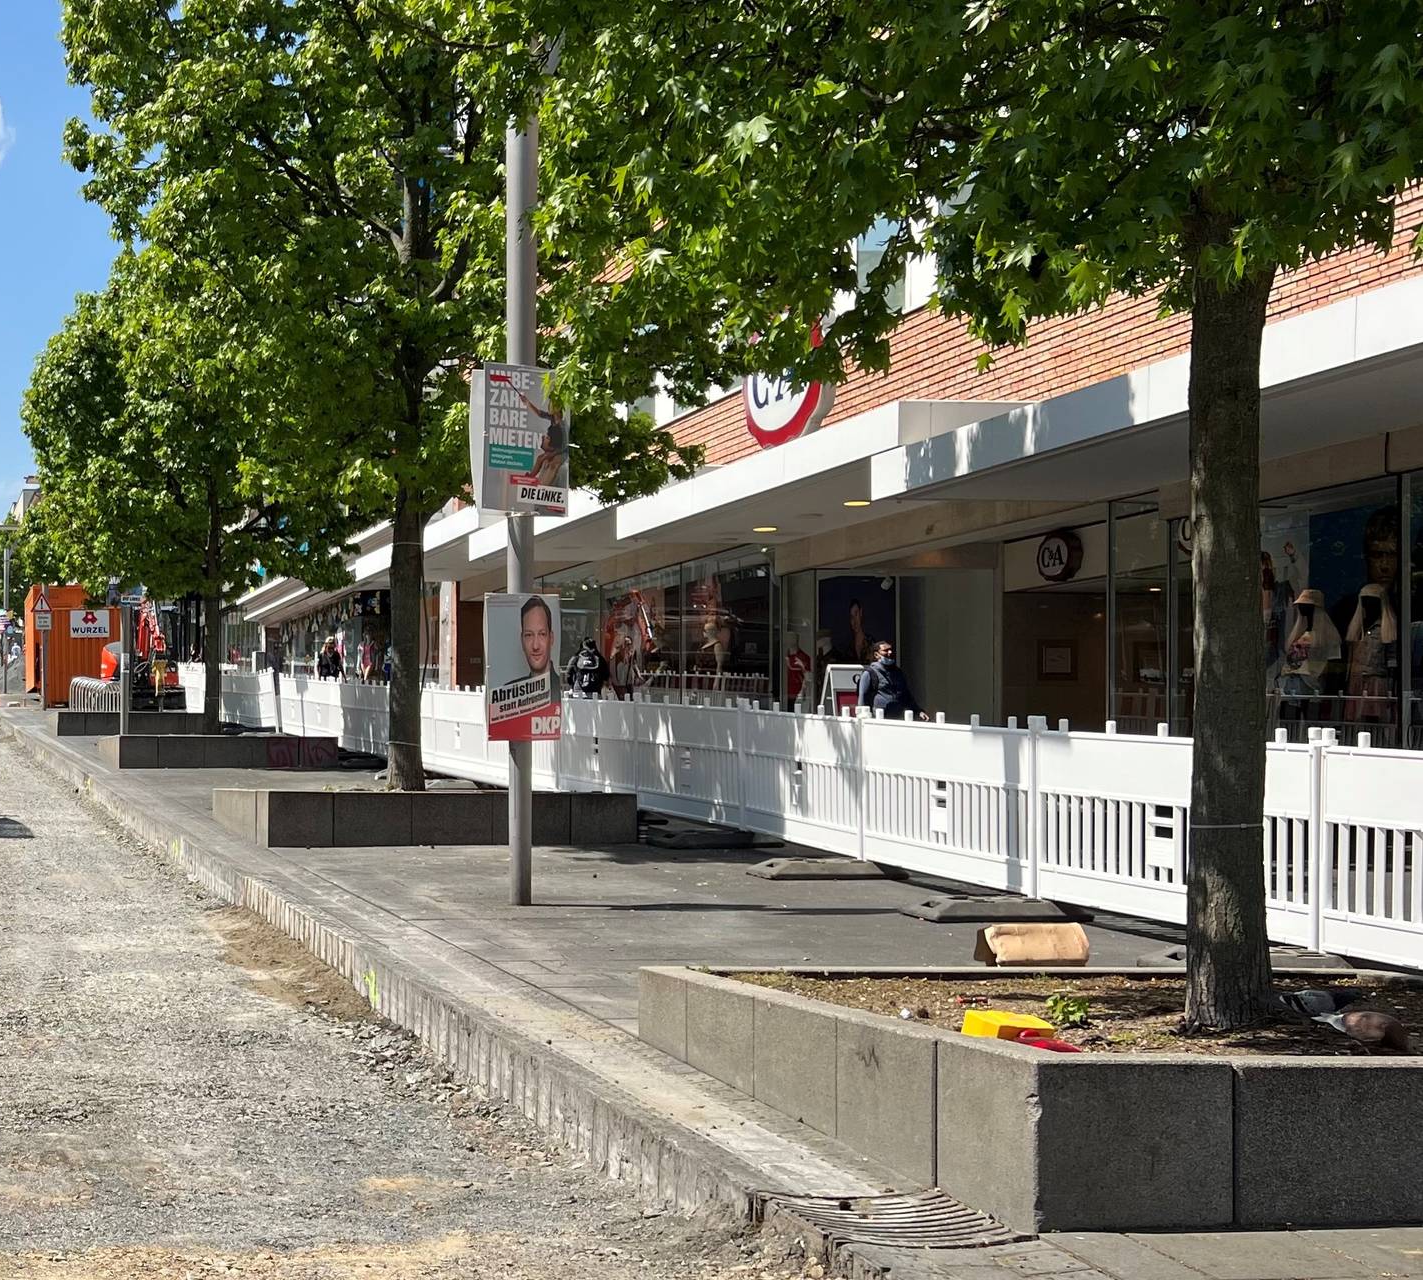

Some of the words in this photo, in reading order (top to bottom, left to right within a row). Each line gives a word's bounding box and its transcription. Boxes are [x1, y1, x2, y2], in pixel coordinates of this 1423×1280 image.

[489, 407, 528, 429] BARE
[489, 427, 543, 450] MIETEN
[520, 487, 536, 500] DIE
[1040, 543, 1065, 568] C&A
[72, 626, 108, 634] WURZEL
[492, 677, 546, 704] Abrüstung
[499, 700, 517, 713] statt
[531, 716, 561, 735] DKP
